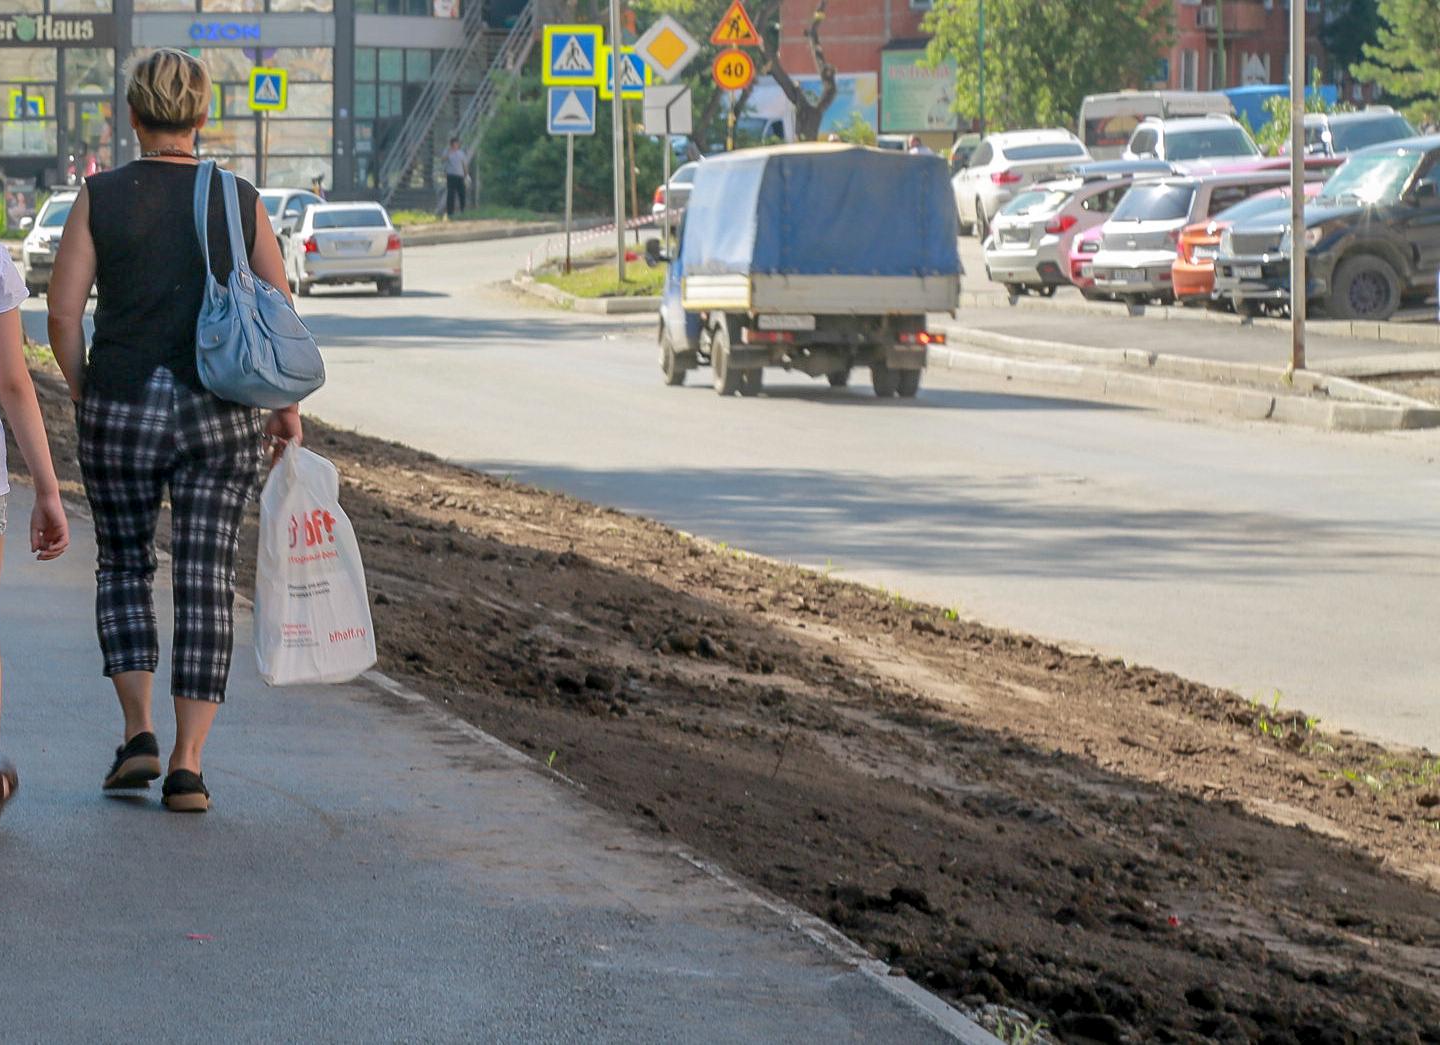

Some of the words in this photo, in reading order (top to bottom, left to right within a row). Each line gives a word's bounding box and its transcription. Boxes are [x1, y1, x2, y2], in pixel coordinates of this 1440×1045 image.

[36, 15, 94, 41] Haus
[189, 23, 261, 41] OZON
[722, 61, 745, 78] 40
